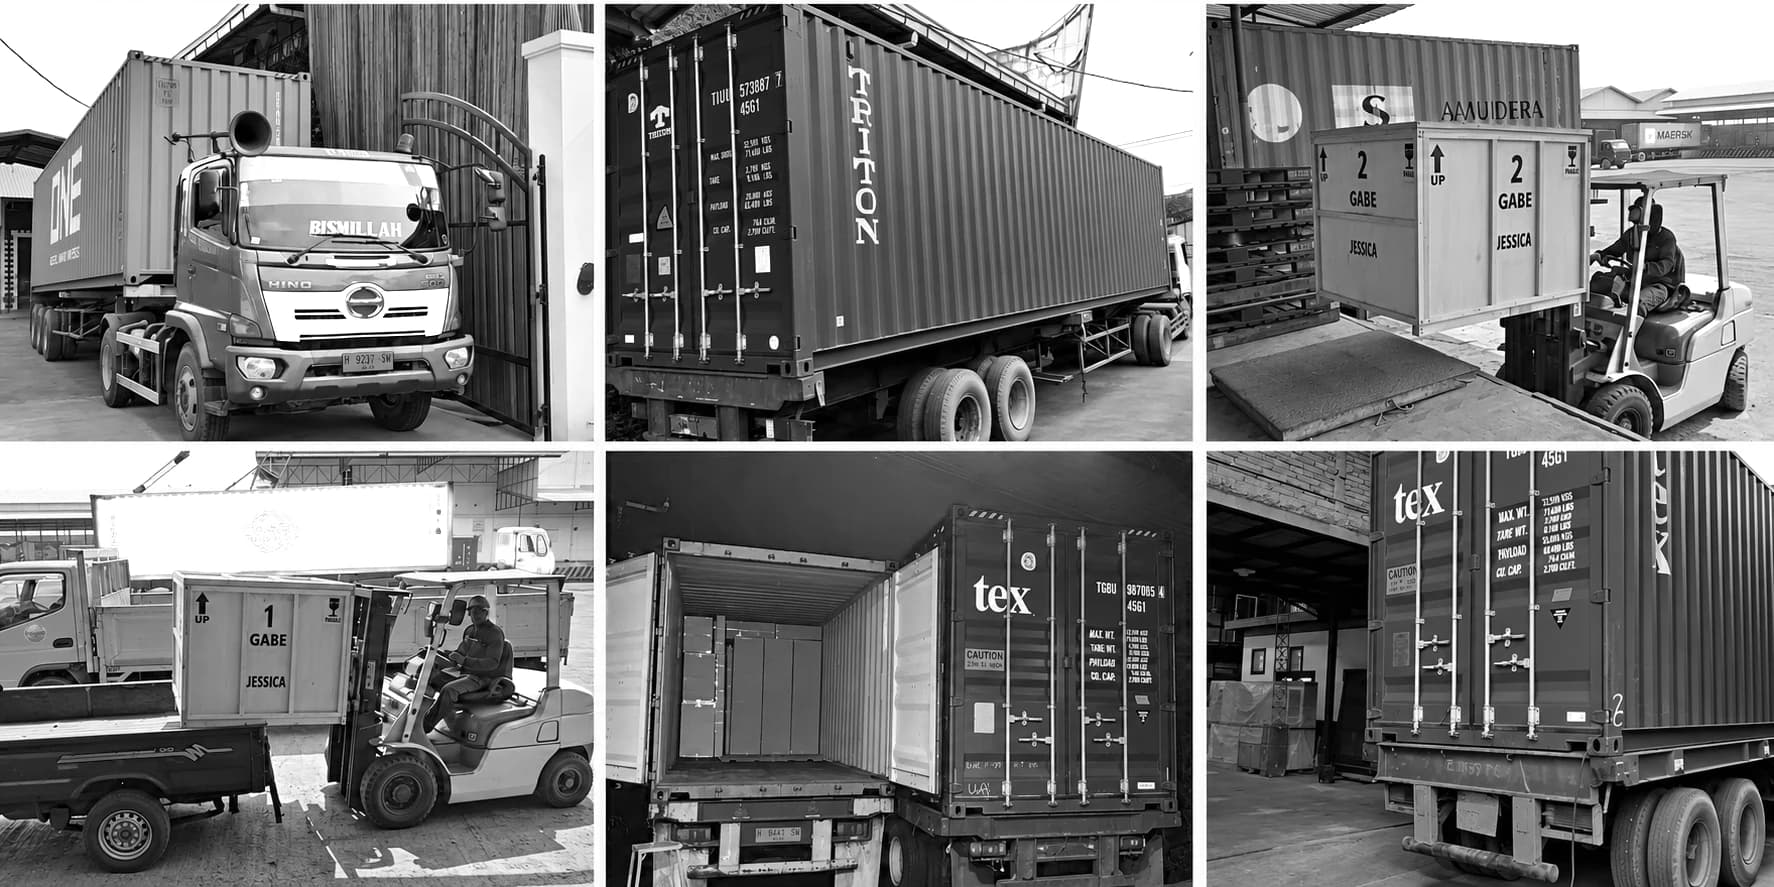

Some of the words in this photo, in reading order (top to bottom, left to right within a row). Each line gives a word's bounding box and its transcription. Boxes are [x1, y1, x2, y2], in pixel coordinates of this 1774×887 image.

[740, 76, 770, 97] 573887
[775, 70, 783, 88] 7
[740, 98, 760, 115] 45G1
[1657, 130, 1693, 140] MAERSK
[848, 65, 880, 245] TRITON
[1358, 150, 1368, 179] 2
[1511, 155, 1523, 183] 2
[1431, 175, 1446, 186] UP
[50, 146, 82, 245] ONE
[1350, 190, 1377, 208] GABE
[1498, 192, 1532, 209] GABE
[309, 220, 401, 237] BISMILLAH
[1350, 240, 1377, 258] JESSICA
[1497, 232, 1532, 250] JESSICA
[268, 281, 312, 289] HINO
[344, 355, 350, 365] H
[1394, 482, 1445, 524] tex
[1498, 545, 1527, 560] PAYLOAD
[973, 575, 1032, 614] tex
[1096, 581, 1117, 594] TGBU
[1127, 600, 1146, 612] 45G1
[195, 615, 210, 624] UP
[264, 604, 274, 628] 1
[250, 633, 287, 647] GABE
[966, 650, 1004, 660] CAUTION
[246, 675, 286, 688] JESSICA
